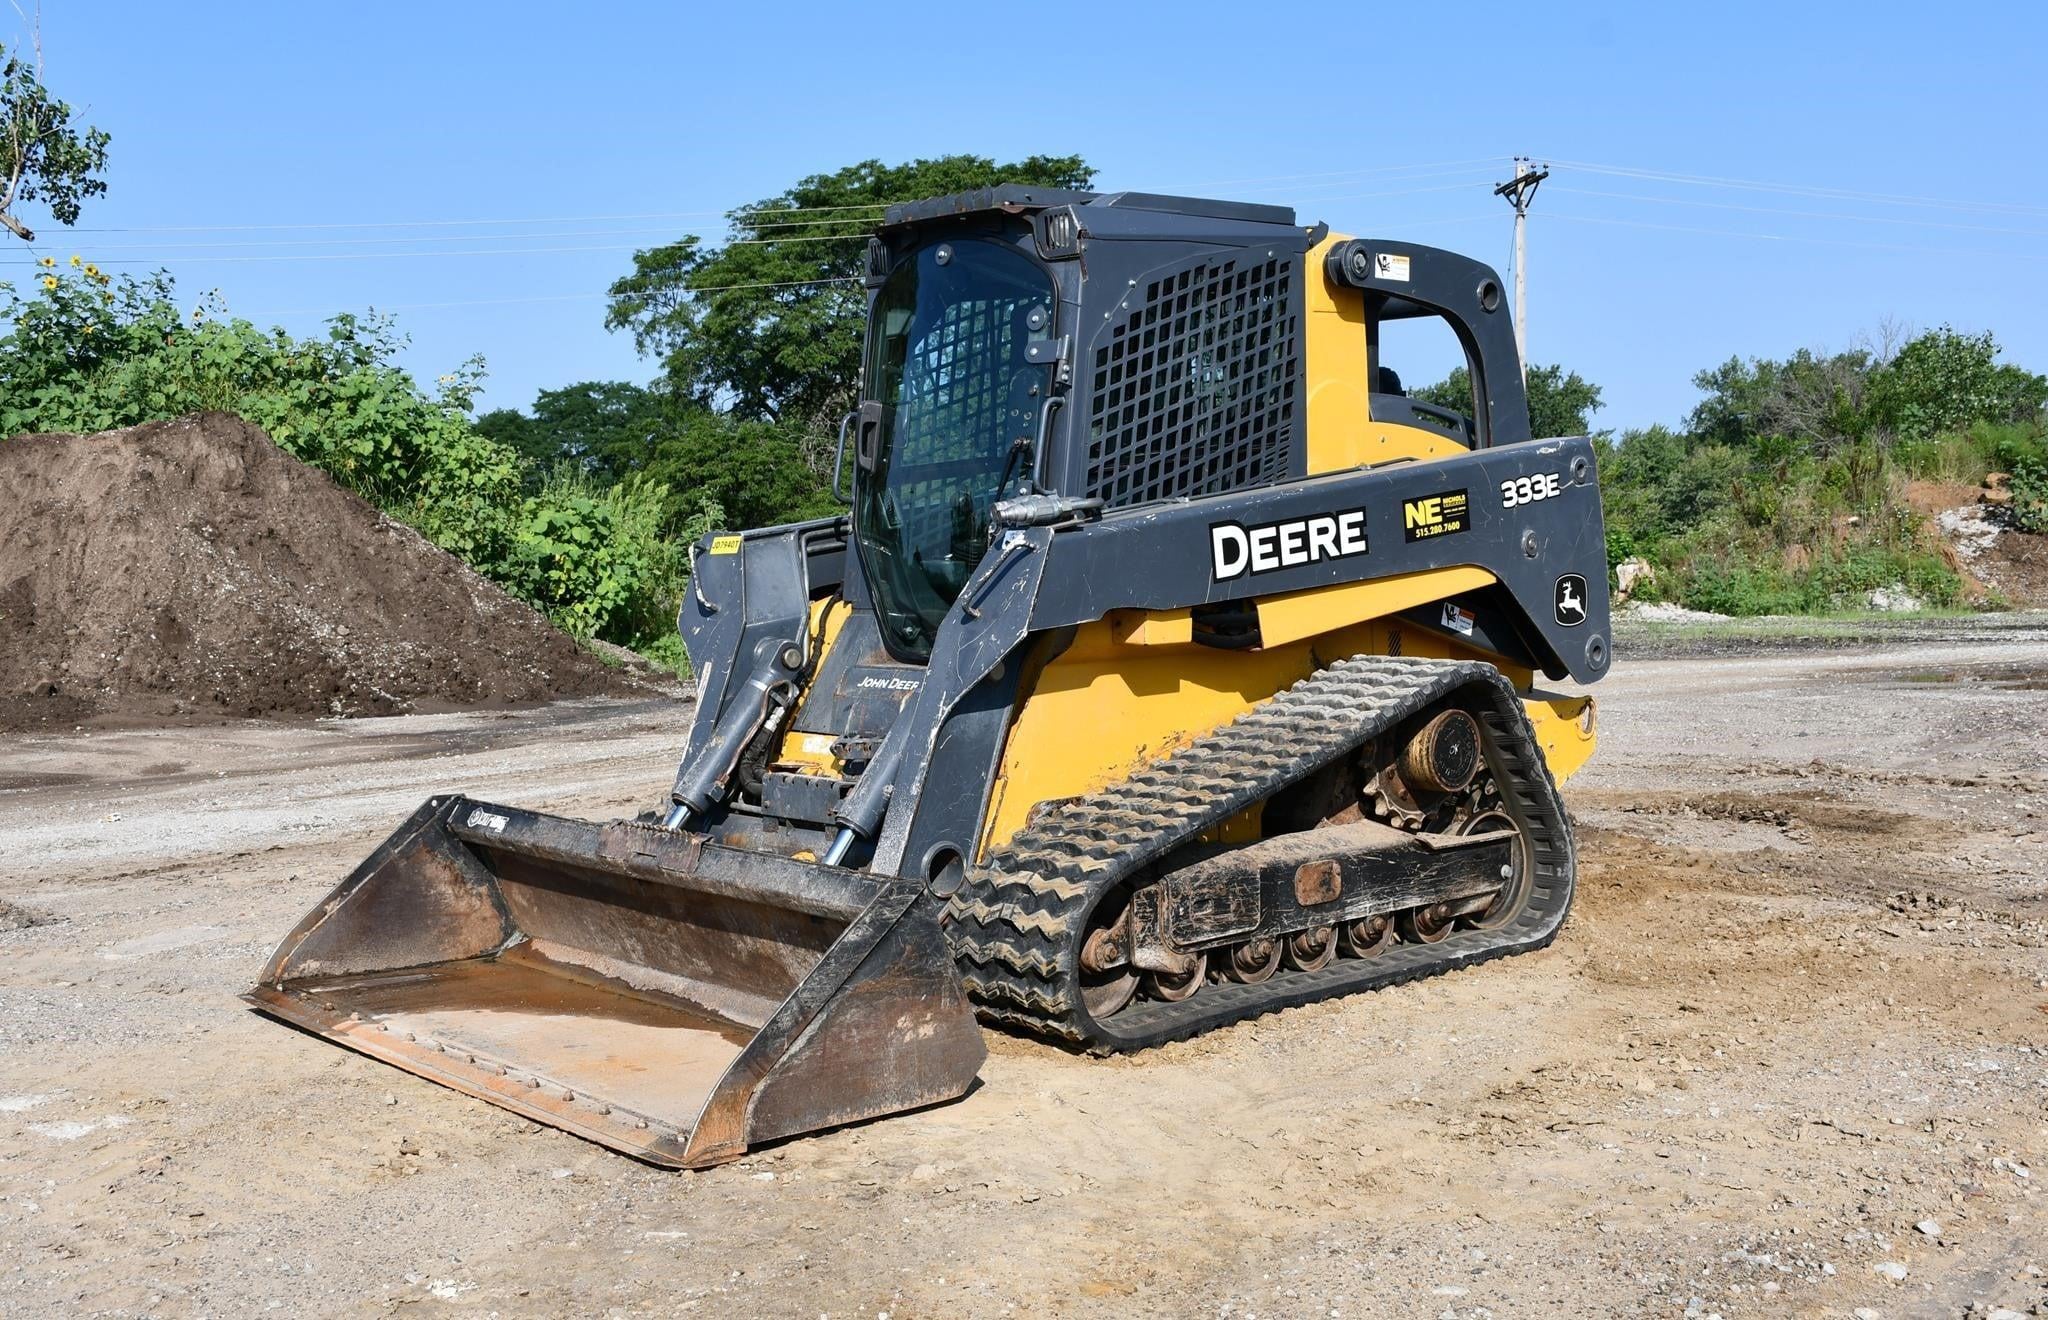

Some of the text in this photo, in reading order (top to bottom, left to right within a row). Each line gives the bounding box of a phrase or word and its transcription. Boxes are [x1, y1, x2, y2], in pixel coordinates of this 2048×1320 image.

[1501, 473, 1560, 508] 333E
[1405, 498, 1442, 528] NE
[1212, 511, 1367, 579] DEERE
[857, 676, 919, 690] JOHN DEER
